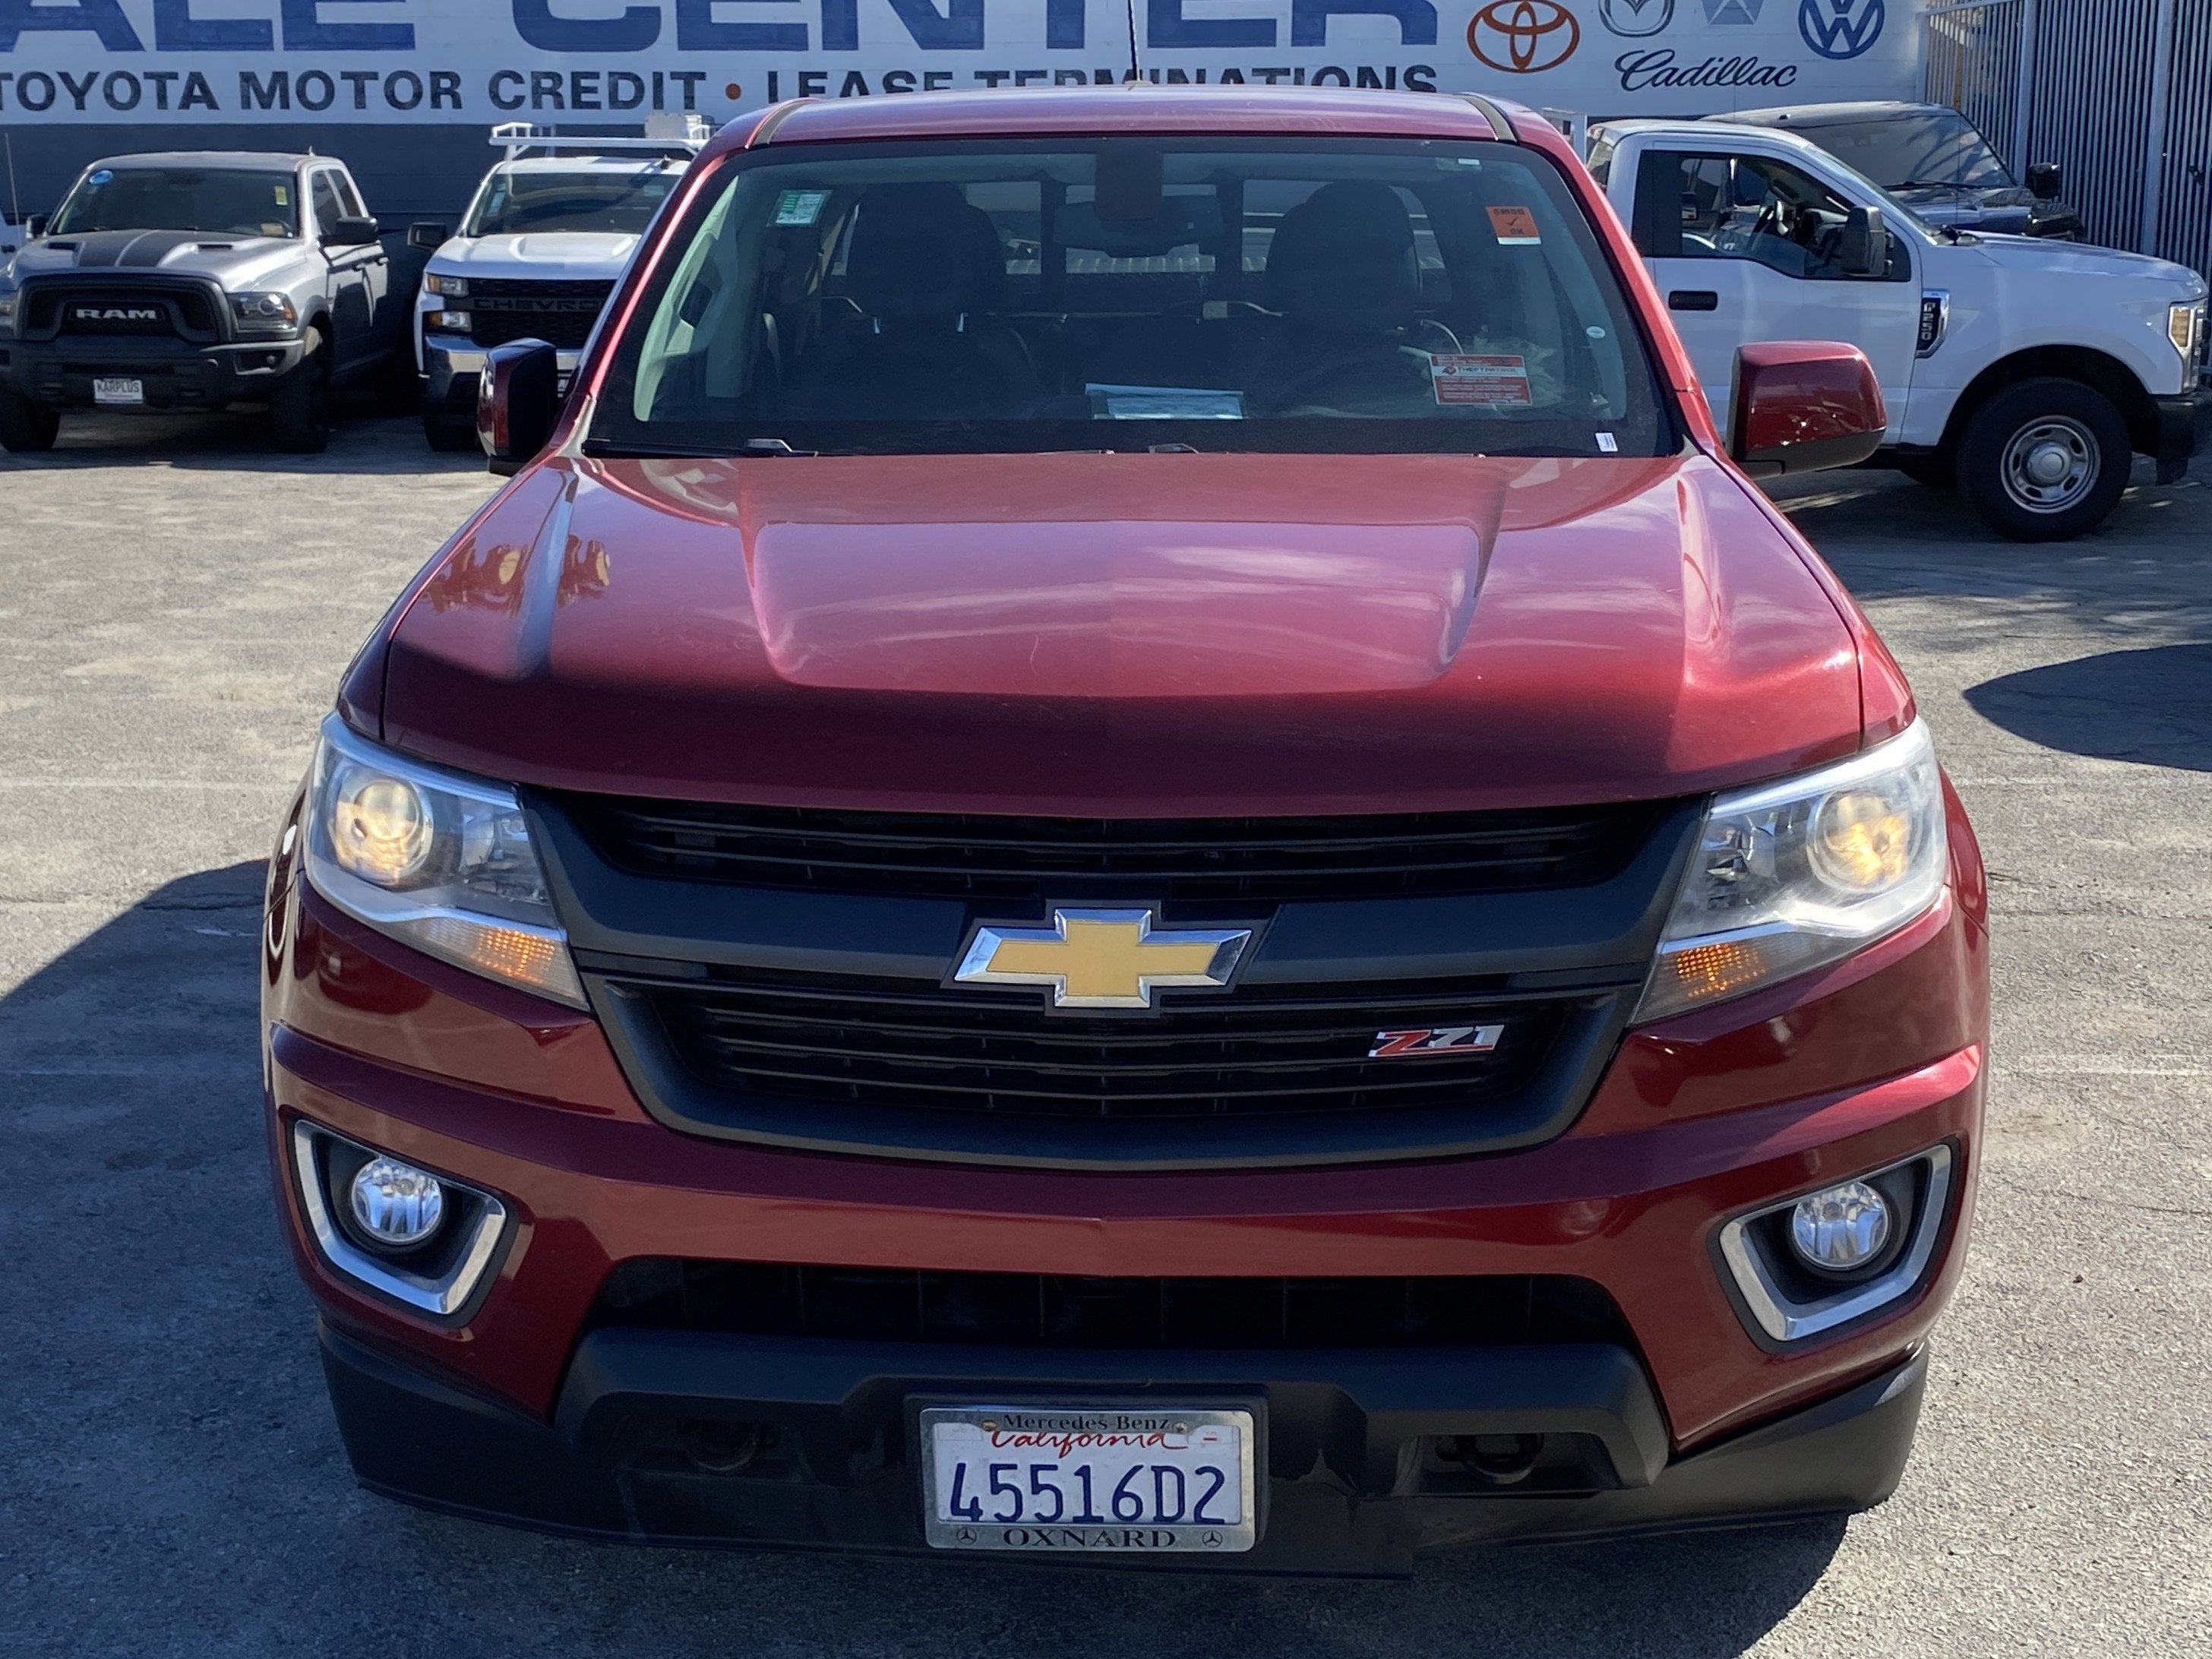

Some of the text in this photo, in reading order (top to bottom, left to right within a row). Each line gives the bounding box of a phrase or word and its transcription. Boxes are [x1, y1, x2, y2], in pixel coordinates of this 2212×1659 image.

[1614, 49, 1797, 91] Cadillac
[239, 70, 462, 111] MOTOR
[488, 70, 706, 110] CREDIT
[77, 309, 156, 318] RAM
[1369, 1024, 1505, 1057] Z71
[991, 1430, 1189, 1458] California
[950, 1462, 1226, 1525] 45516D2
[1003, 1528, 1177, 1548] OXNARD
